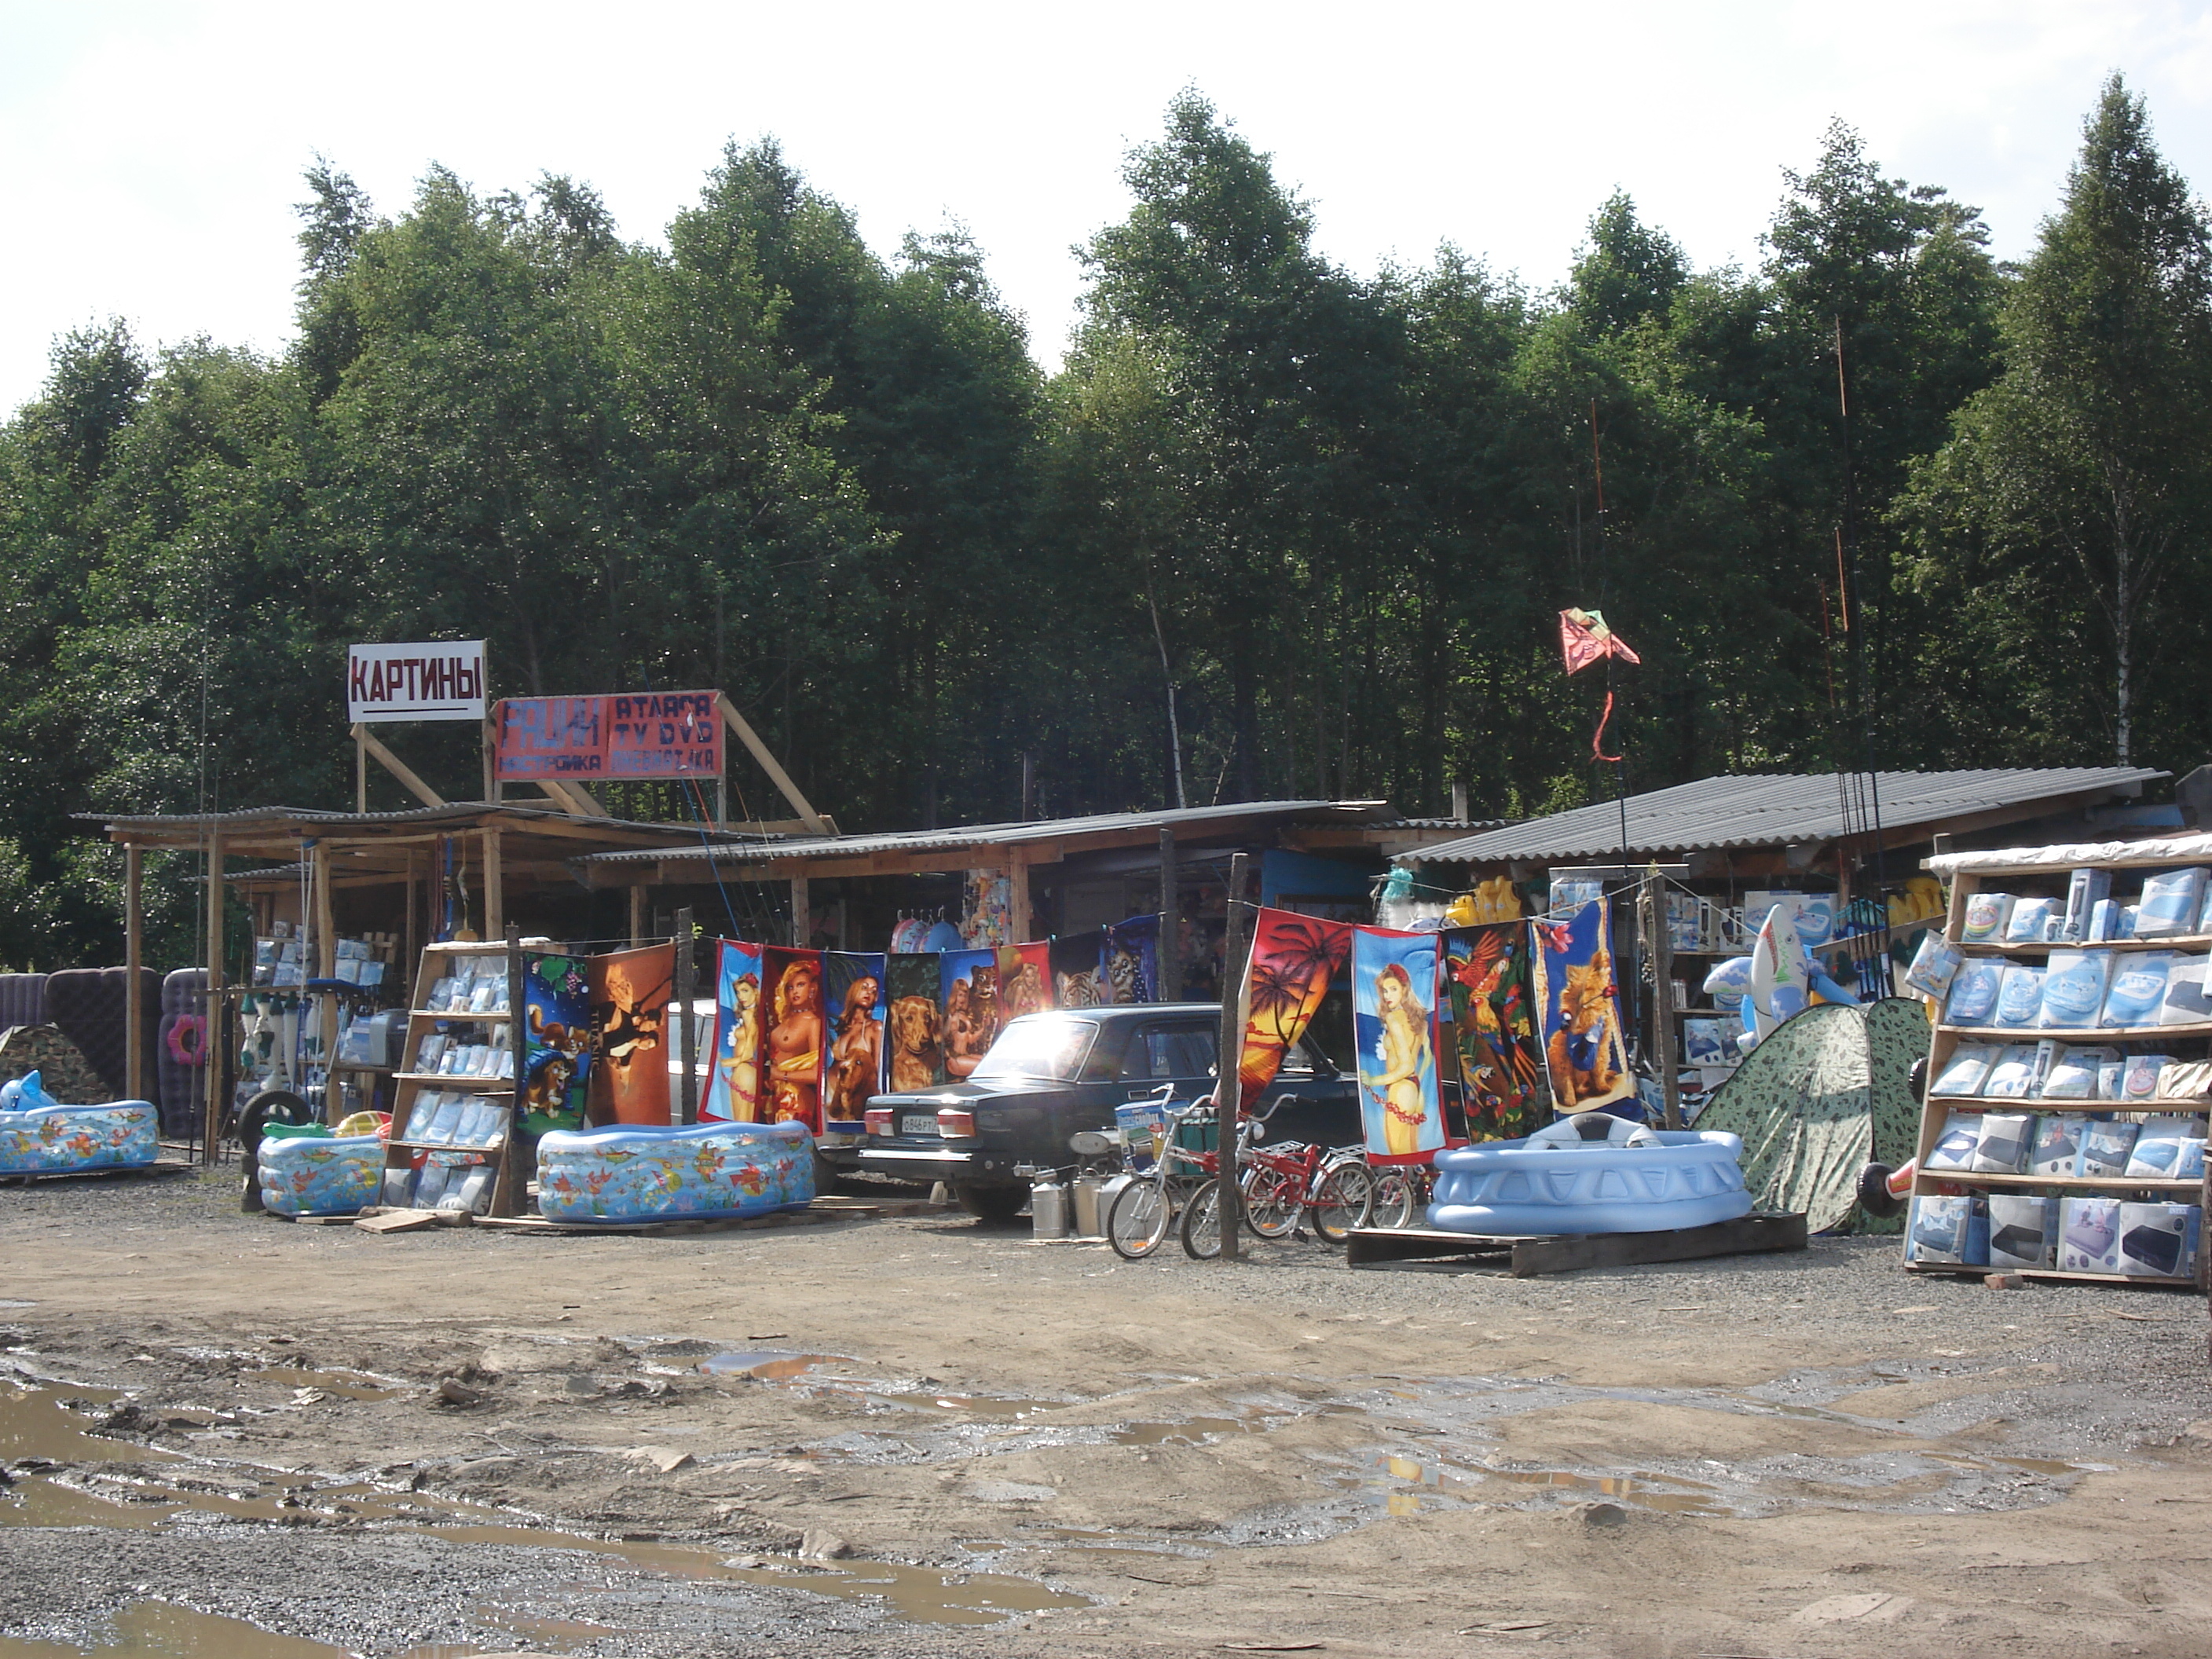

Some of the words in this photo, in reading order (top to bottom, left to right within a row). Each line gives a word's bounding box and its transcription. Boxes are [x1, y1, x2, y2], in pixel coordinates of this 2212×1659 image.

[351, 655, 482, 702] КАРТИНЫ
[614, 723, 648, 745] TV
[659, 720, 712, 745] DVD
